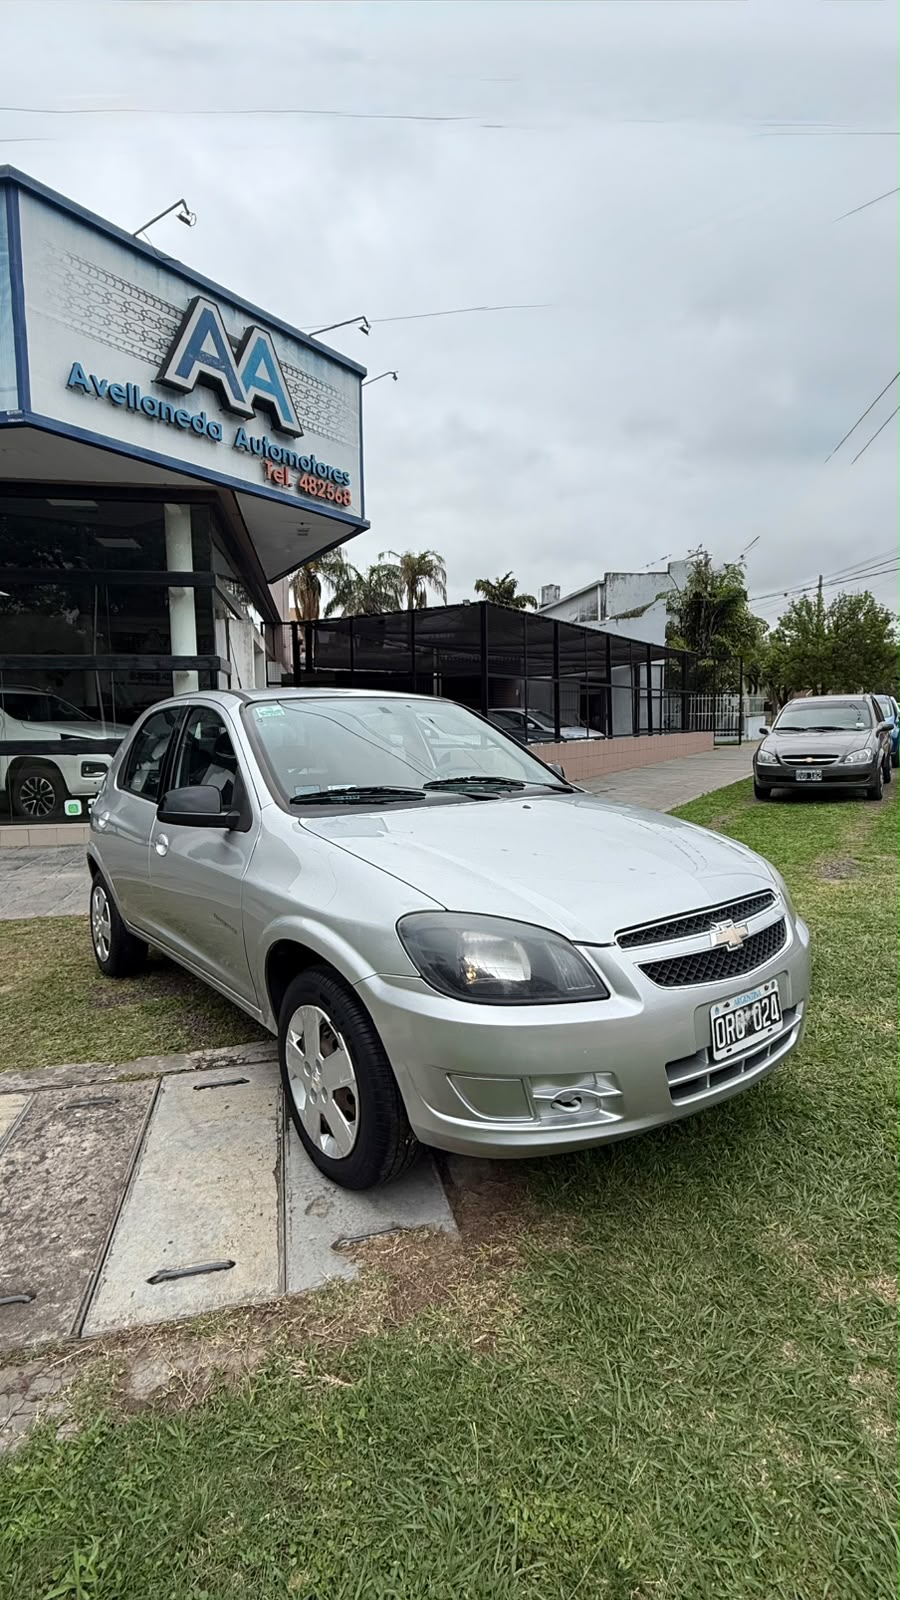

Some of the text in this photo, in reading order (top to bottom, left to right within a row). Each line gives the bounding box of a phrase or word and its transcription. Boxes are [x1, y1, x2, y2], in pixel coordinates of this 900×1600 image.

[157, 296, 304, 437] AA
[66, 361, 351, 486] Avellaneda Automotores
[264, 460, 352, 507] Tel. 482568
[752, 993, 780, 1031] 024
